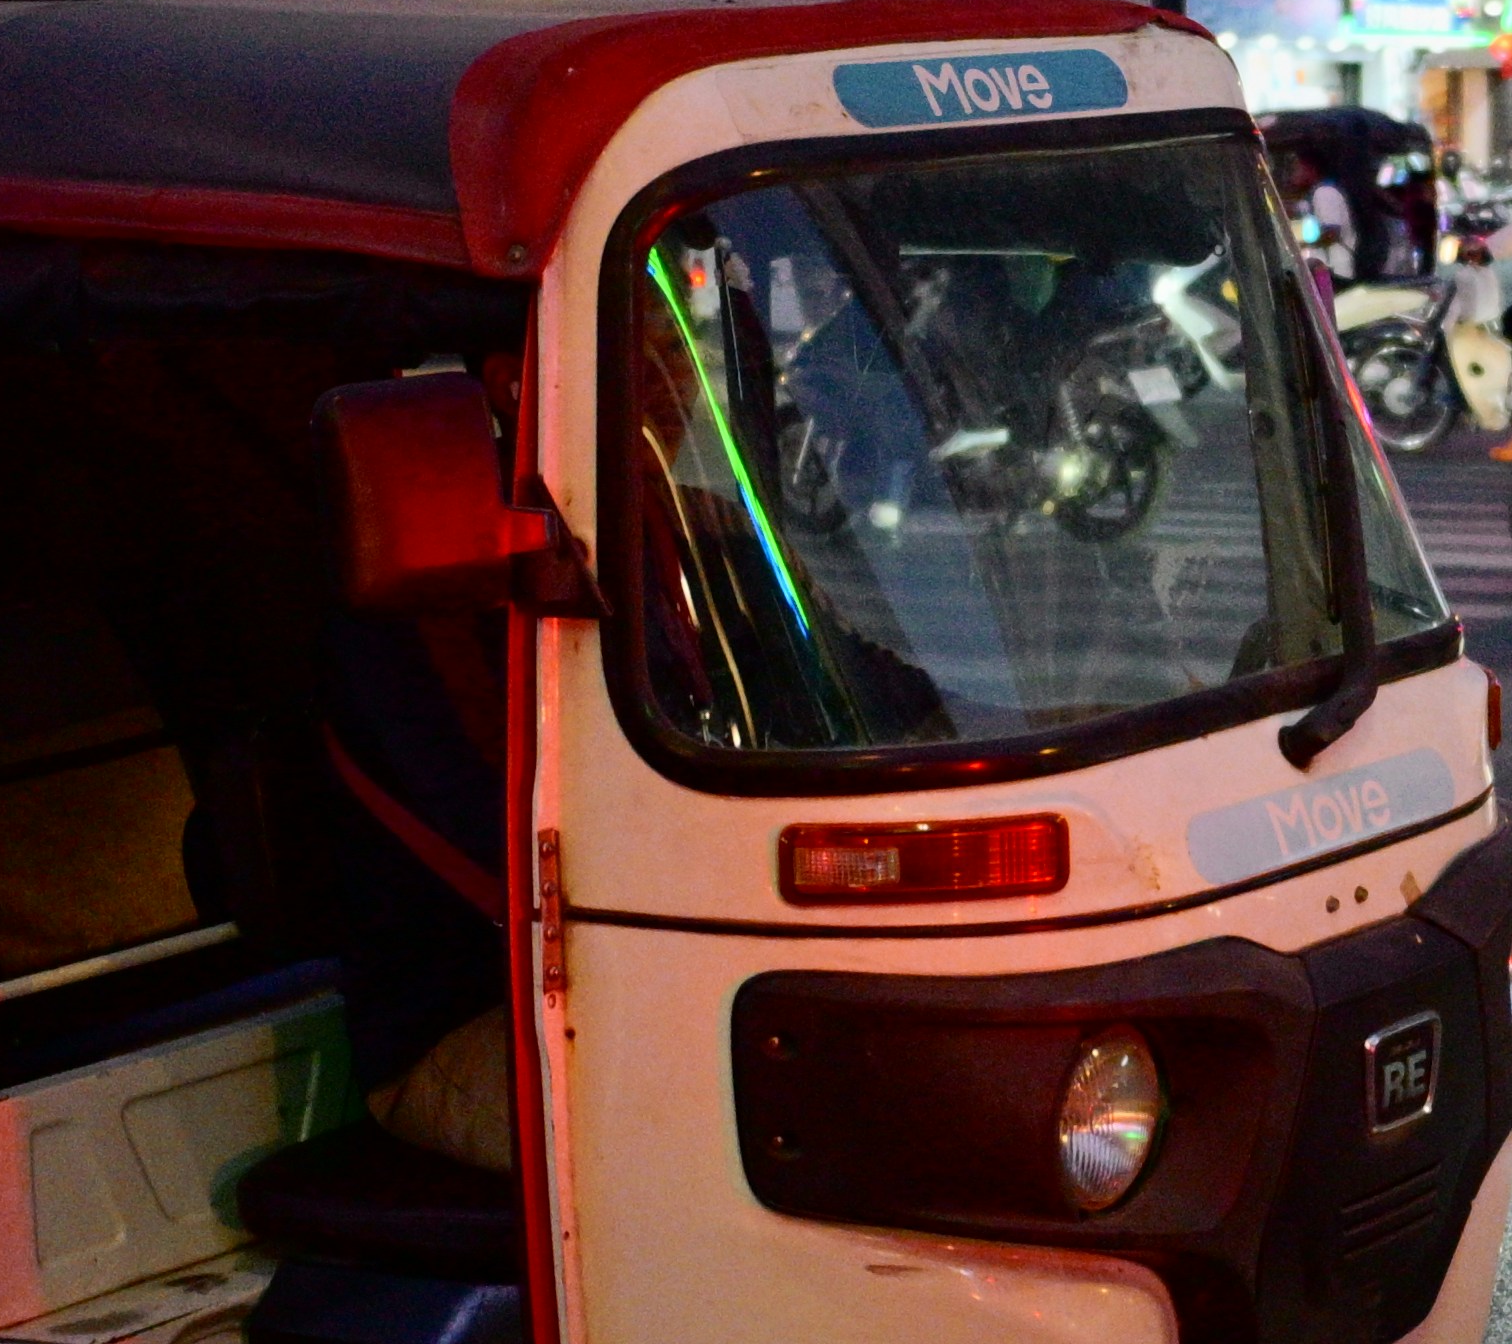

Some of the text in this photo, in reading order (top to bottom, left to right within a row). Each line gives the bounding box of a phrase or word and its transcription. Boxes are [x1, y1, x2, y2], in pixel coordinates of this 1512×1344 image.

[911, 62, 1053, 117] Move
[1265, 779, 1392, 857] Move
[1382, 1049, 1428, 1109] RE
